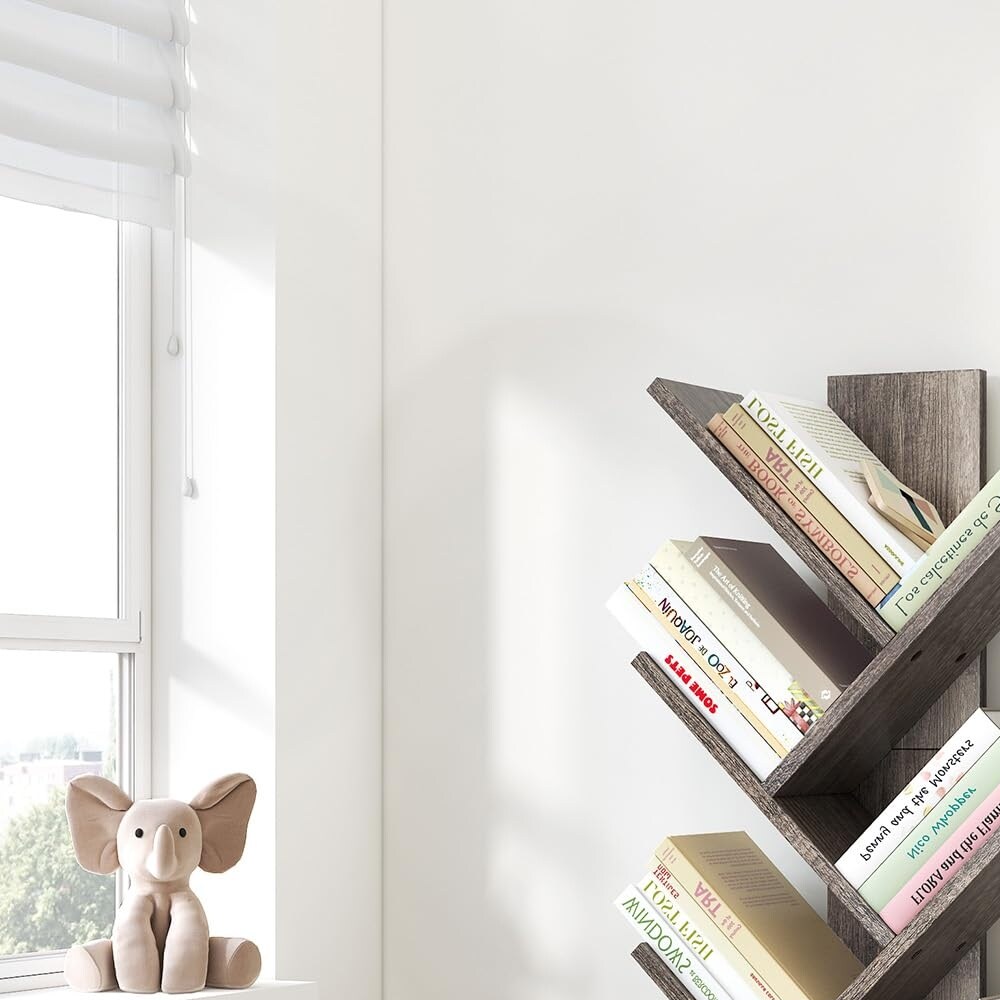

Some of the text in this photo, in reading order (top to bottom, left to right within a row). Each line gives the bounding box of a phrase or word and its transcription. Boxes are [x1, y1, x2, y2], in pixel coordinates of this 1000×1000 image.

[698, 645, 708, 656] DE
[665, 654, 719, 714] SOME PETS
